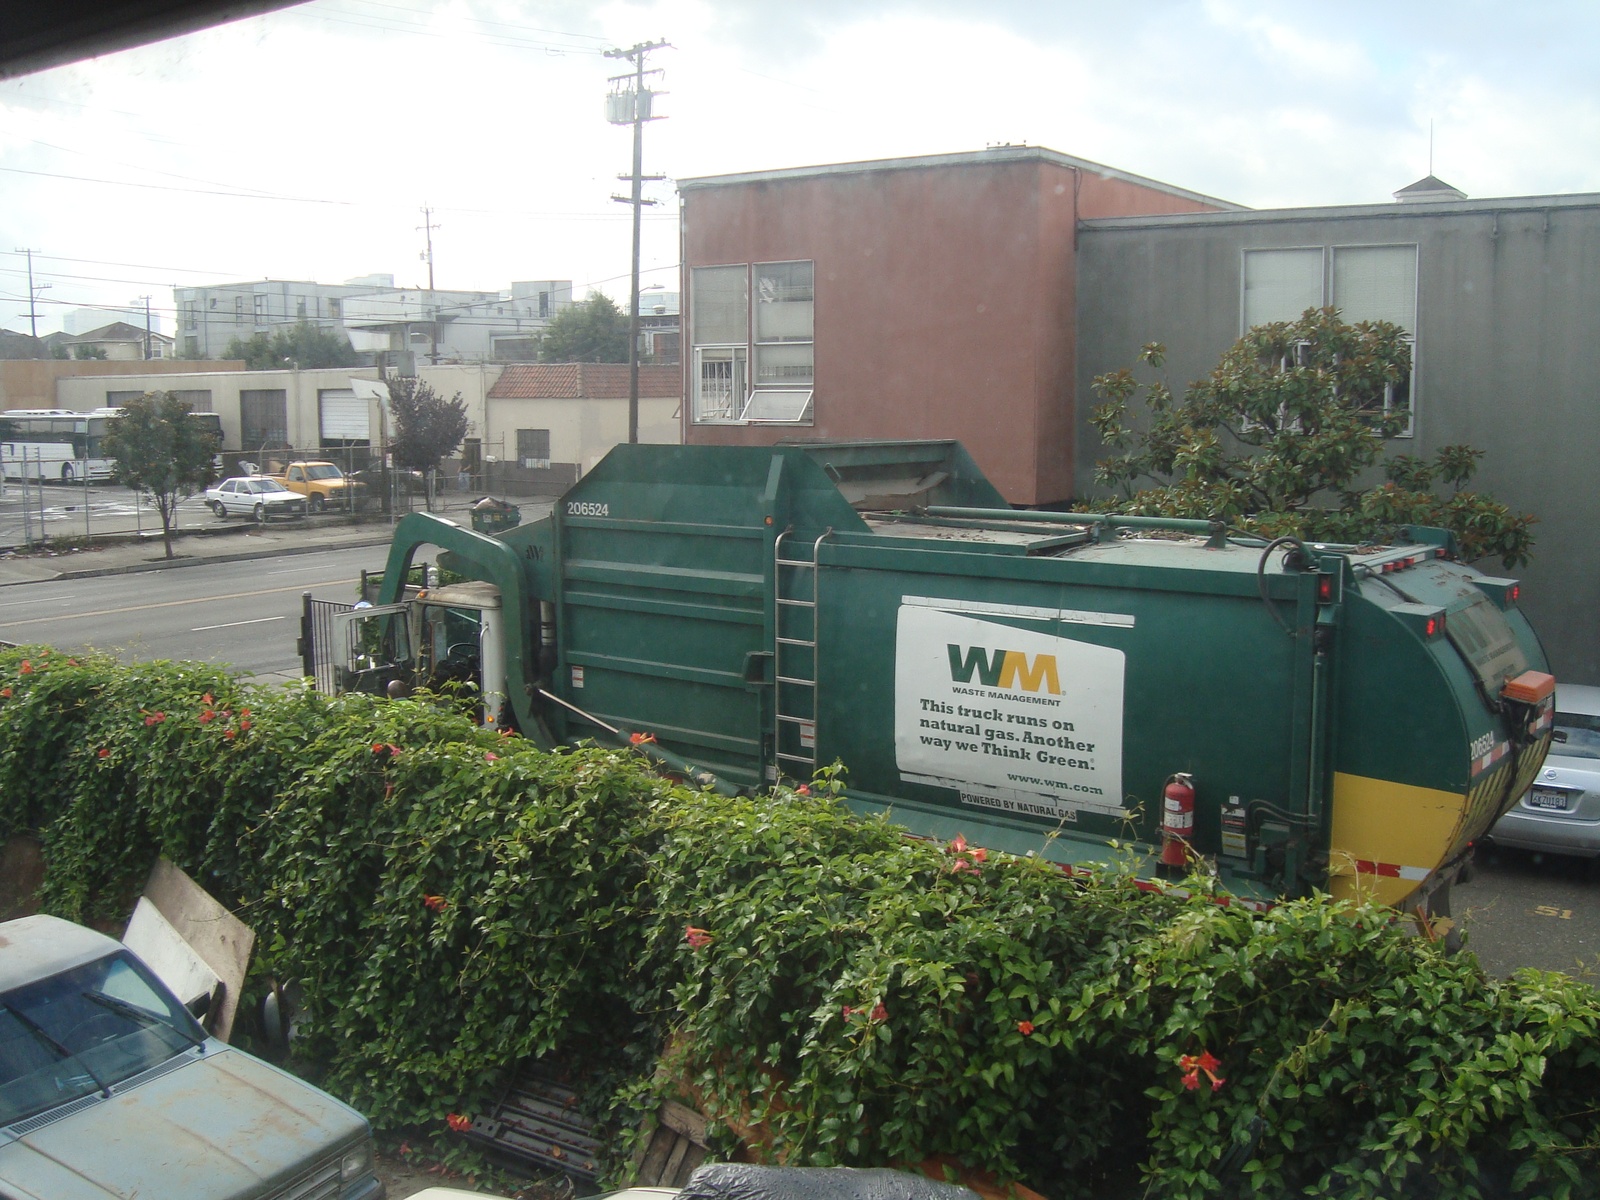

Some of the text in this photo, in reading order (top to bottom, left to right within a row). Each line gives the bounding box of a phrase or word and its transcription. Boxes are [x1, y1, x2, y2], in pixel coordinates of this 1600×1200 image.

[567, 502, 609, 517] 206524
[947, 643, 1061, 695] WM
[952, 686, 1062, 707] WASTE MANAGEMENT
[919, 698, 1075, 732] This truck runs on
[919, 718, 1096, 753] natural gas. Another
[919, 734, 952, 751] way
[955, 740, 979, 753] we
[981, 742, 1031, 761] Think
[1470, 730, 1494, 761] 206524
[1007, 772, 1104, 796] www.wm.com
[961, 792, 1077, 821] POWERED BY NATURAL GAS
